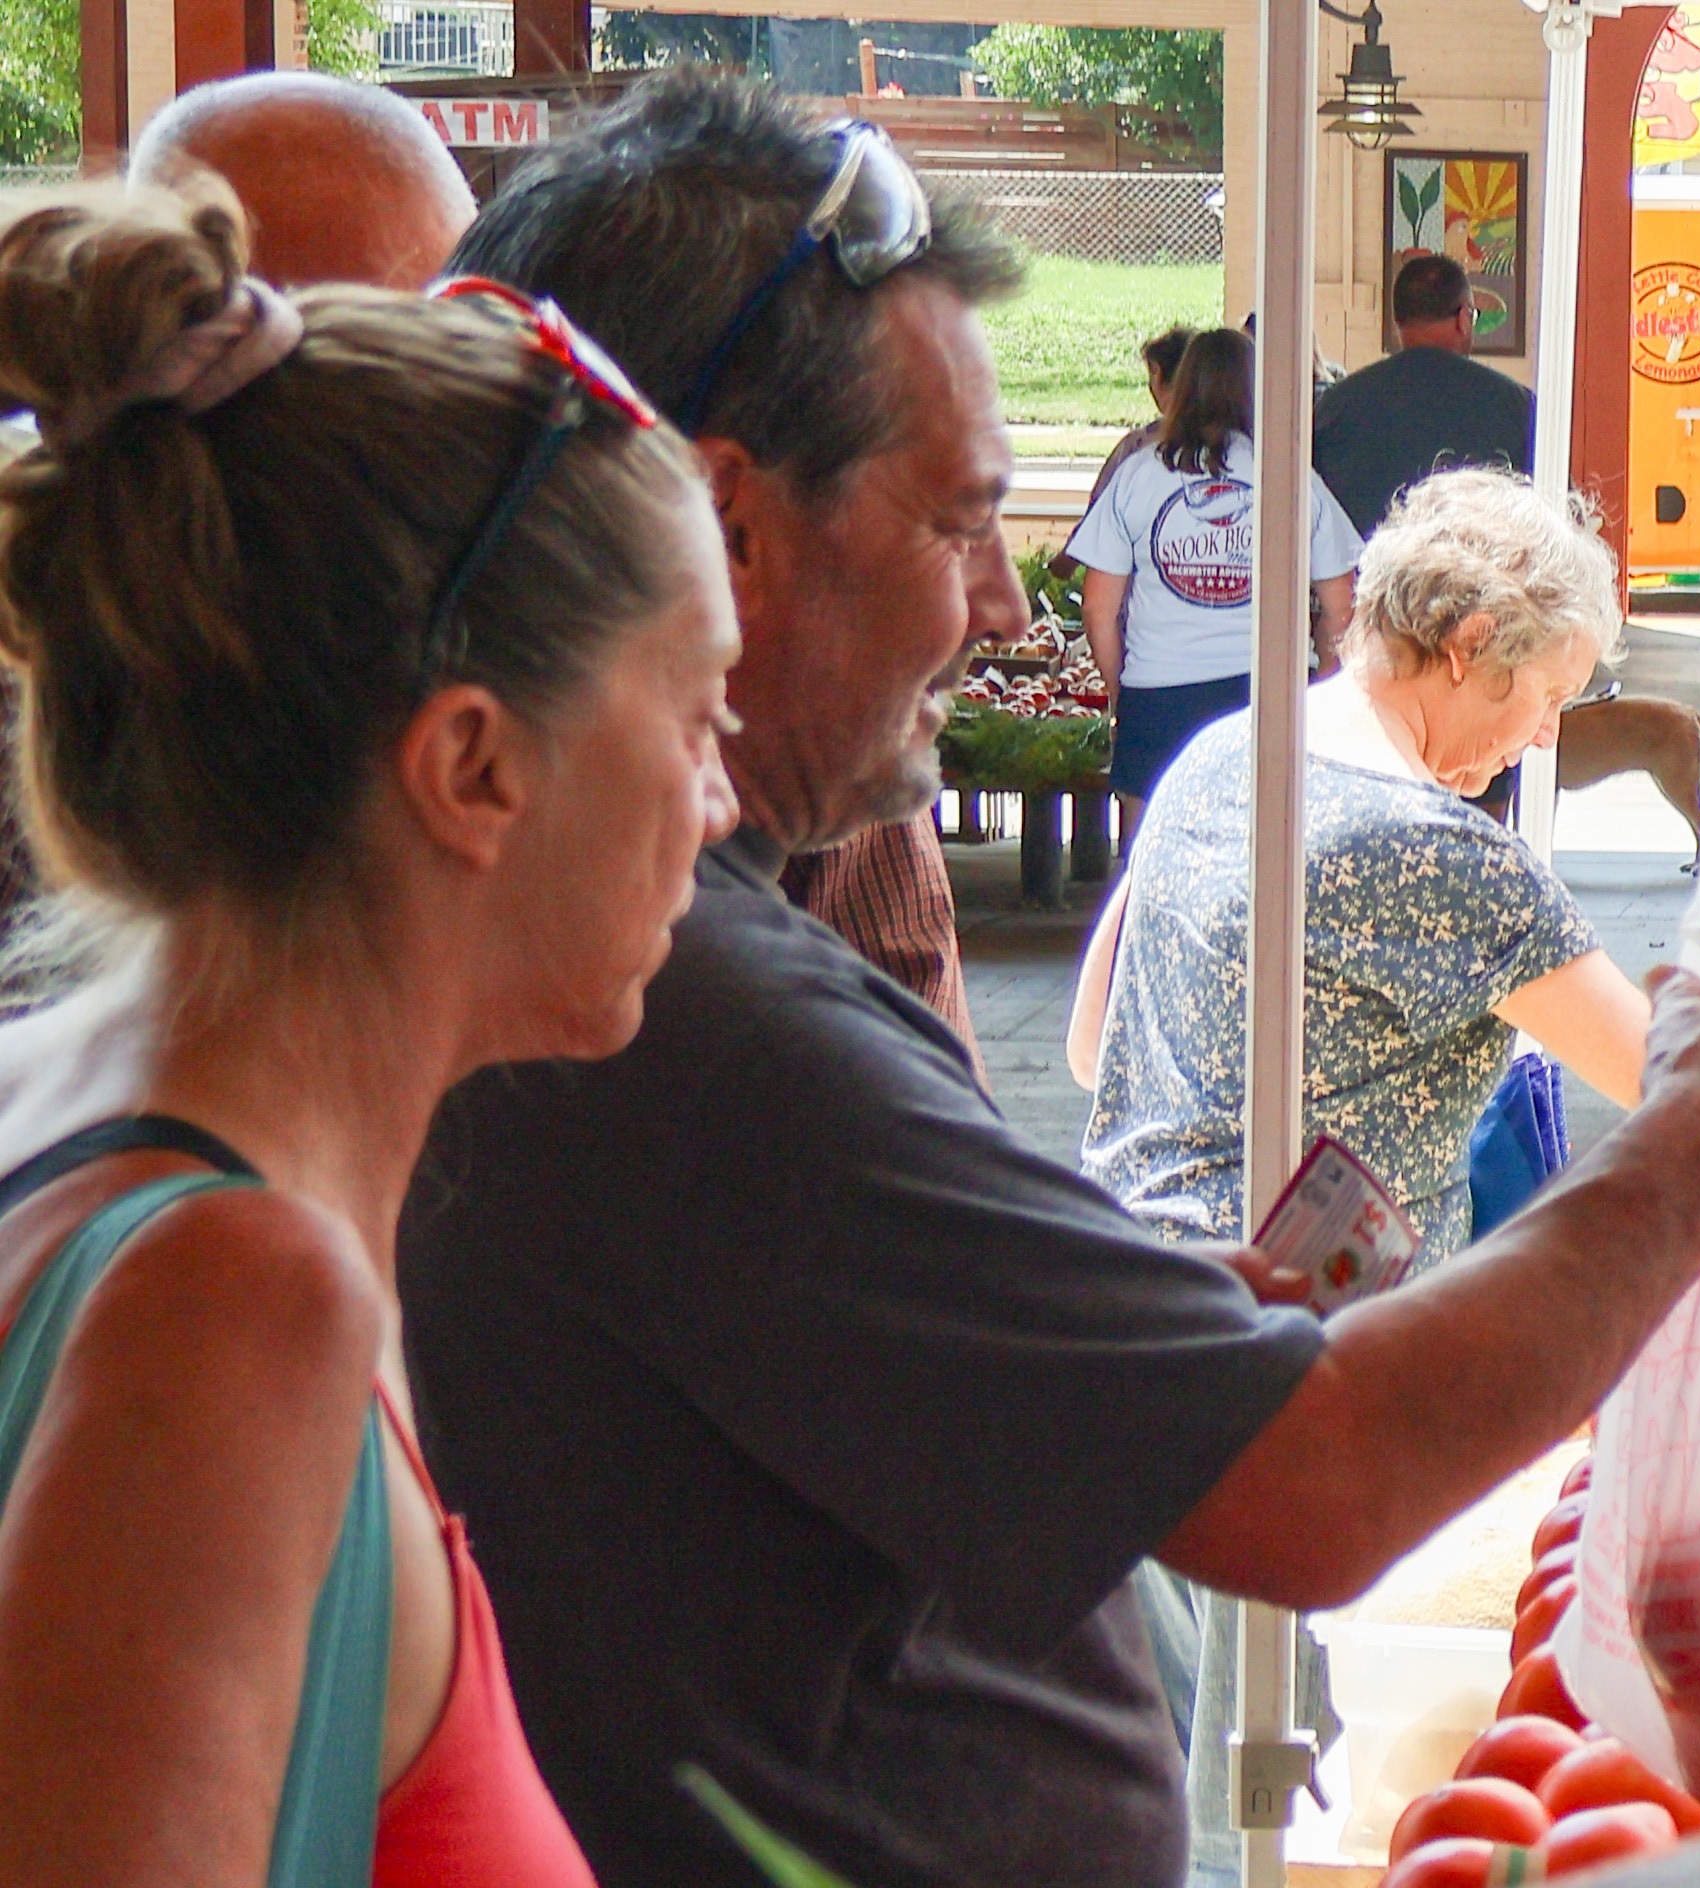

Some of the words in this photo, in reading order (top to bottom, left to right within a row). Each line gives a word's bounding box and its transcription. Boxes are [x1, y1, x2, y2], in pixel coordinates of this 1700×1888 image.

[422, 103, 537, 144] ATM
[1161, 530, 1221, 565] SNOOK
[1225, 524, 1252, 553] BIG
[1167, 565, 1218, 578] BACKWATER
[1219, 565, 1251, 579] ADVENT
